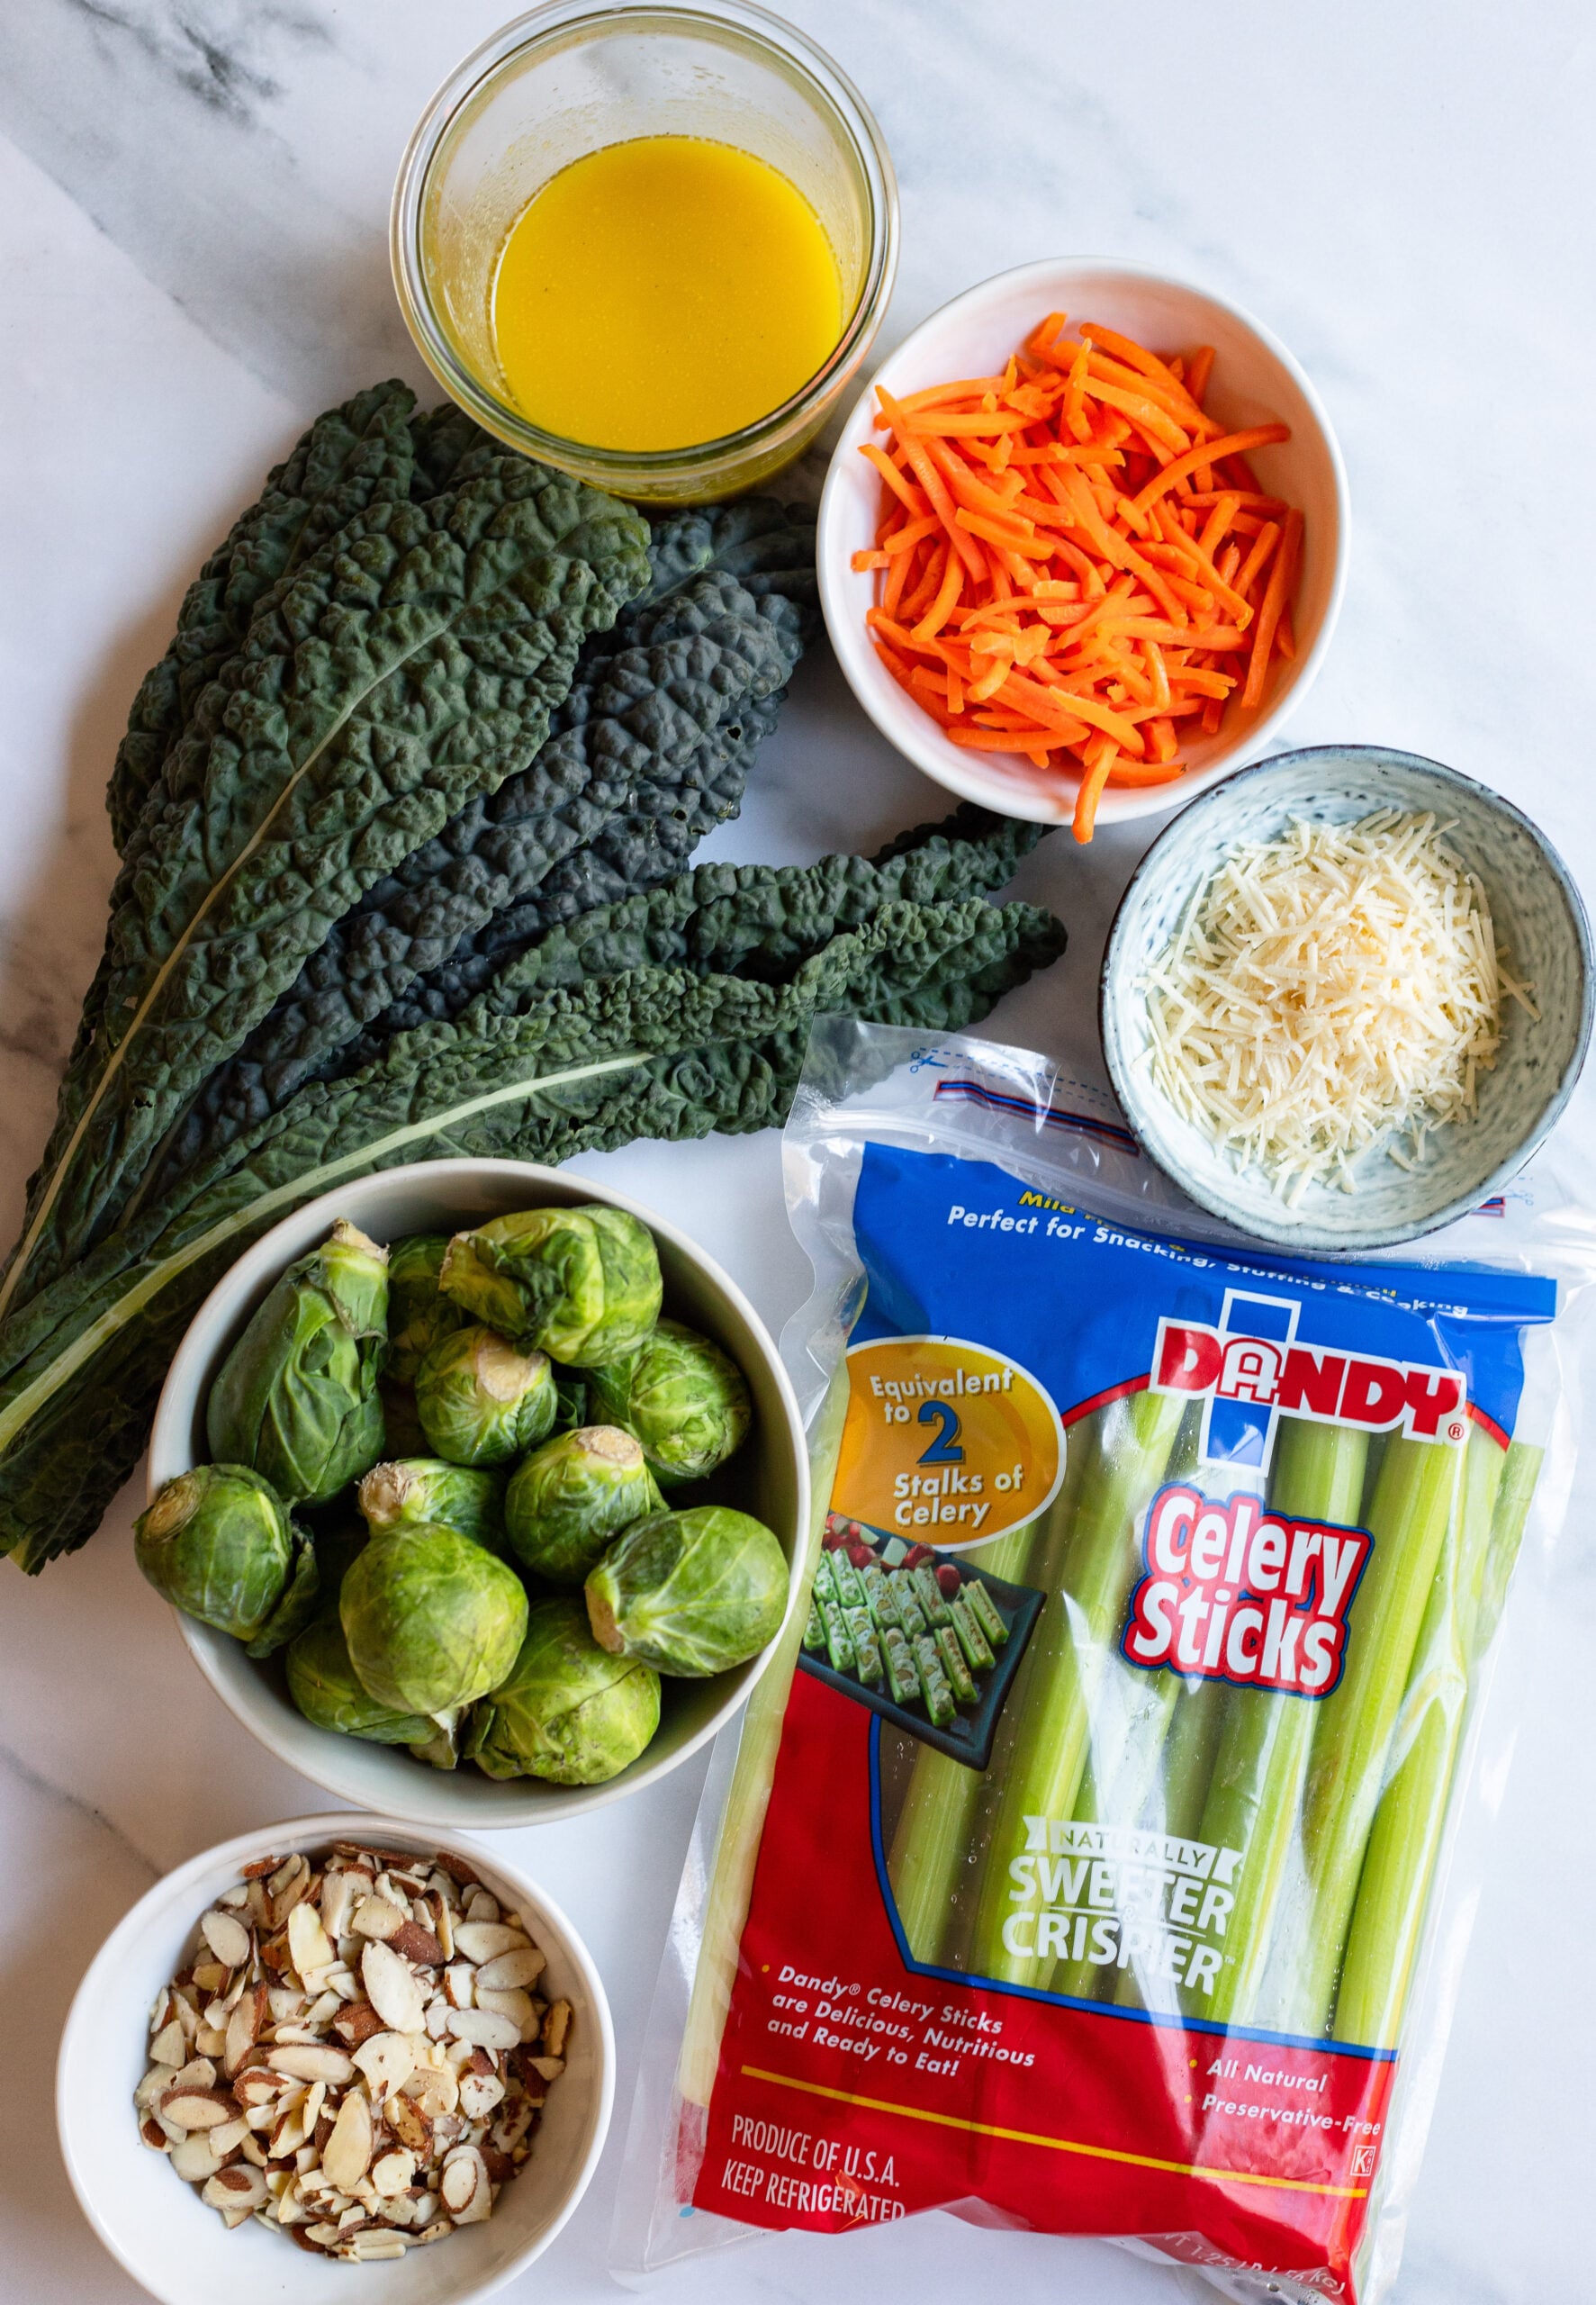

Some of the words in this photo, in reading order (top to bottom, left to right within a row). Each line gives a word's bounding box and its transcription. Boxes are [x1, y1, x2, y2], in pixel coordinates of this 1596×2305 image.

[947, 1206, 1039, 1234] Perfect
[1046, 1216, 1086, 1240] for
[1092, 1226, 1216, 1269] Snacking,
[870, 1368, 1015, 1403] Equivalent
[884, 1402, 912, 1424] to
[915, 1399, 966, 1468] 2
[894, 1468, 985, 1499] Stalks
[995, 1464, 1024, 1492] of
[895, 1496, 992, 1529] Celery
[1154, 1495, 1362, 1618] Celery
[1132, 1580, 1338, 1688] Sticks
[1059, 1829, 1208, 1869] NATURALLY
[1008, 1855, 1235, 1937] SWEETER
[772, 1993, 808, 2013] are
[815, 2001, 915, 2043] Delicious,
[923, 2028, 1035, 2067] Nutritious
[867, 1988, 934, 2022] Celery
[941, 2005, 1004, 2035] Sticks
[767, 2017, 809, 2039] and
[813, 2026, 881, 2062] Ready
[886, 2047, 908, 2065] to
[915, 2051, 960, 2077] Eat!
[1206, 2058, 1239, 2079] All
[1244, 2064, 1329, 2093] Natural
[1202, 2093, 1382, 2137] Preservative-Free
[731, 2114, 812, 2165] PRODUCE
[813, 2138, 842, 2172] OF
[843, 2146, 900, 2188] U.S.A.
[721, 2158, 764, 2197] KEEP
[765, 2173, 906, 2222] REFRIGERATED
[1164, 2233, 1191, 2247] T
